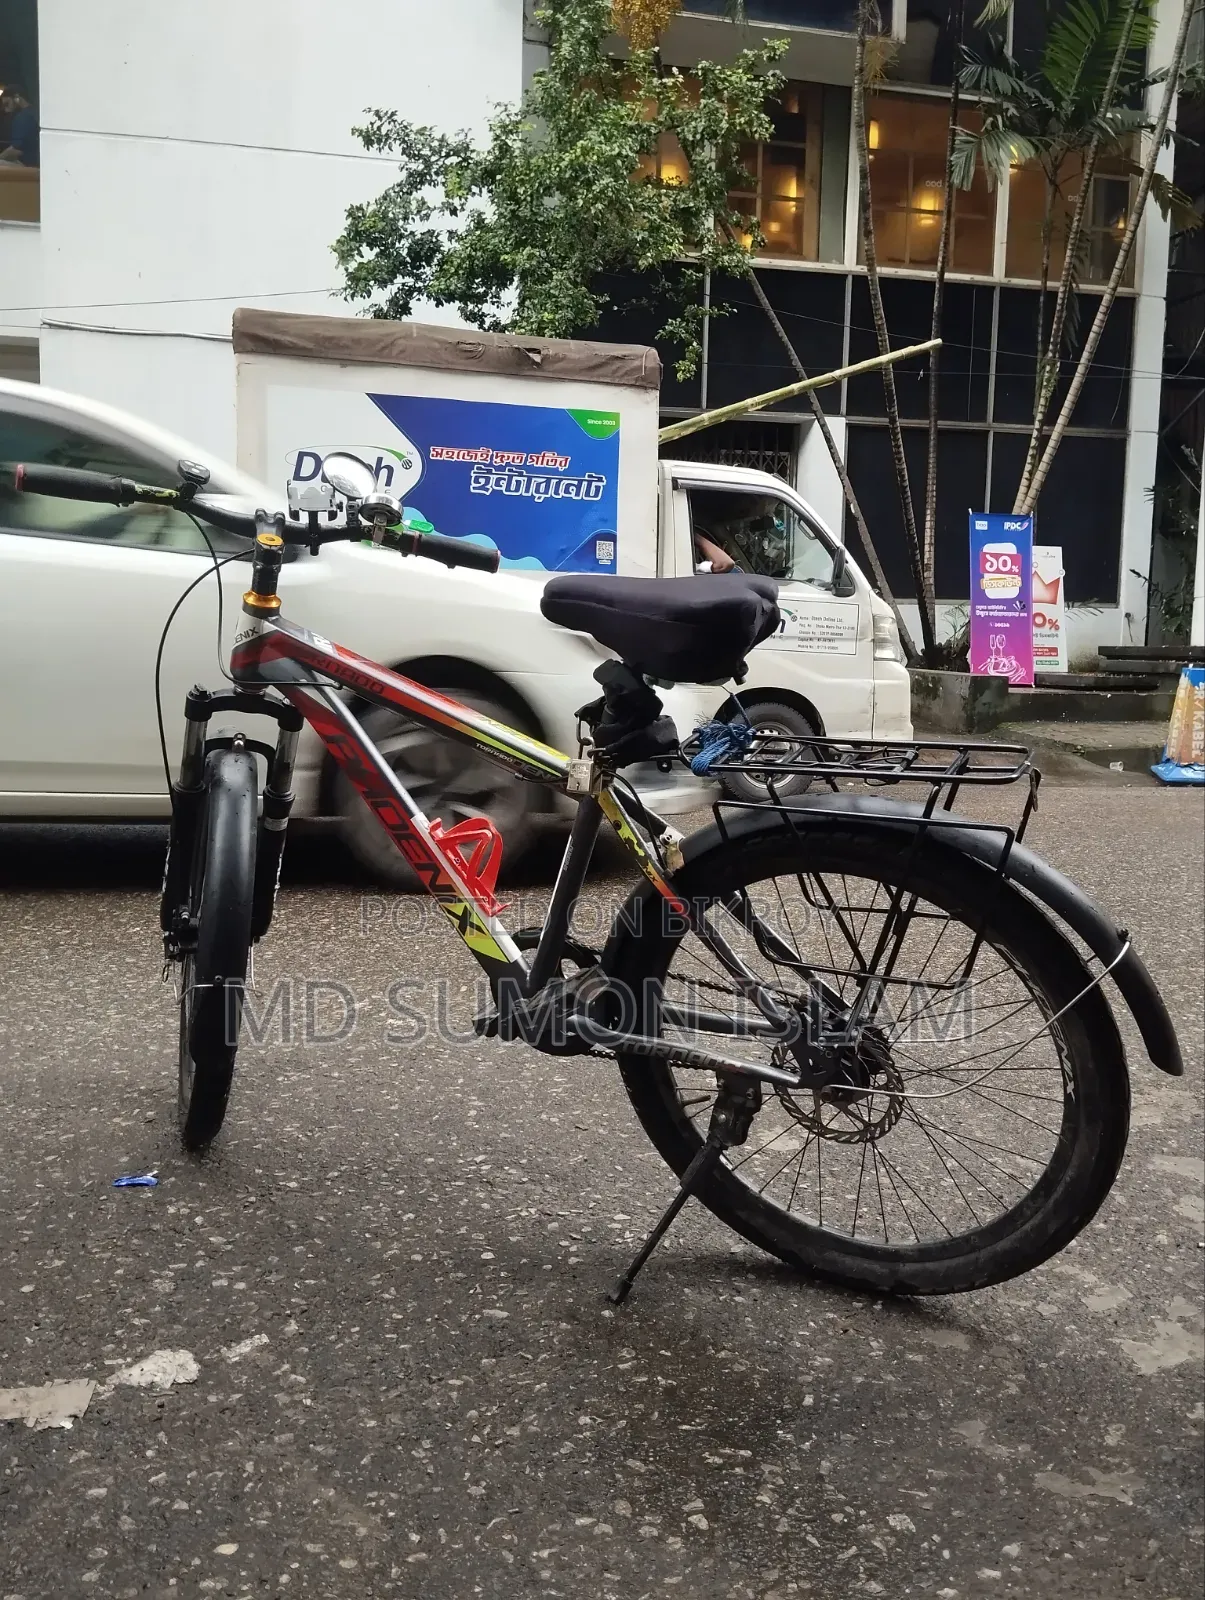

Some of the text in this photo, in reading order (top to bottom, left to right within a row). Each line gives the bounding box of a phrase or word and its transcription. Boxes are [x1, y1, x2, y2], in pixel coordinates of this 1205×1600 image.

[430, 446, 571, 471] সহজেই দ্রুত গতির
[470, 465, 606, 502] ইন্টারনেট
[1003, 521, 1021, 530] IPDC
[235, 626, 259, 644] ENIX
